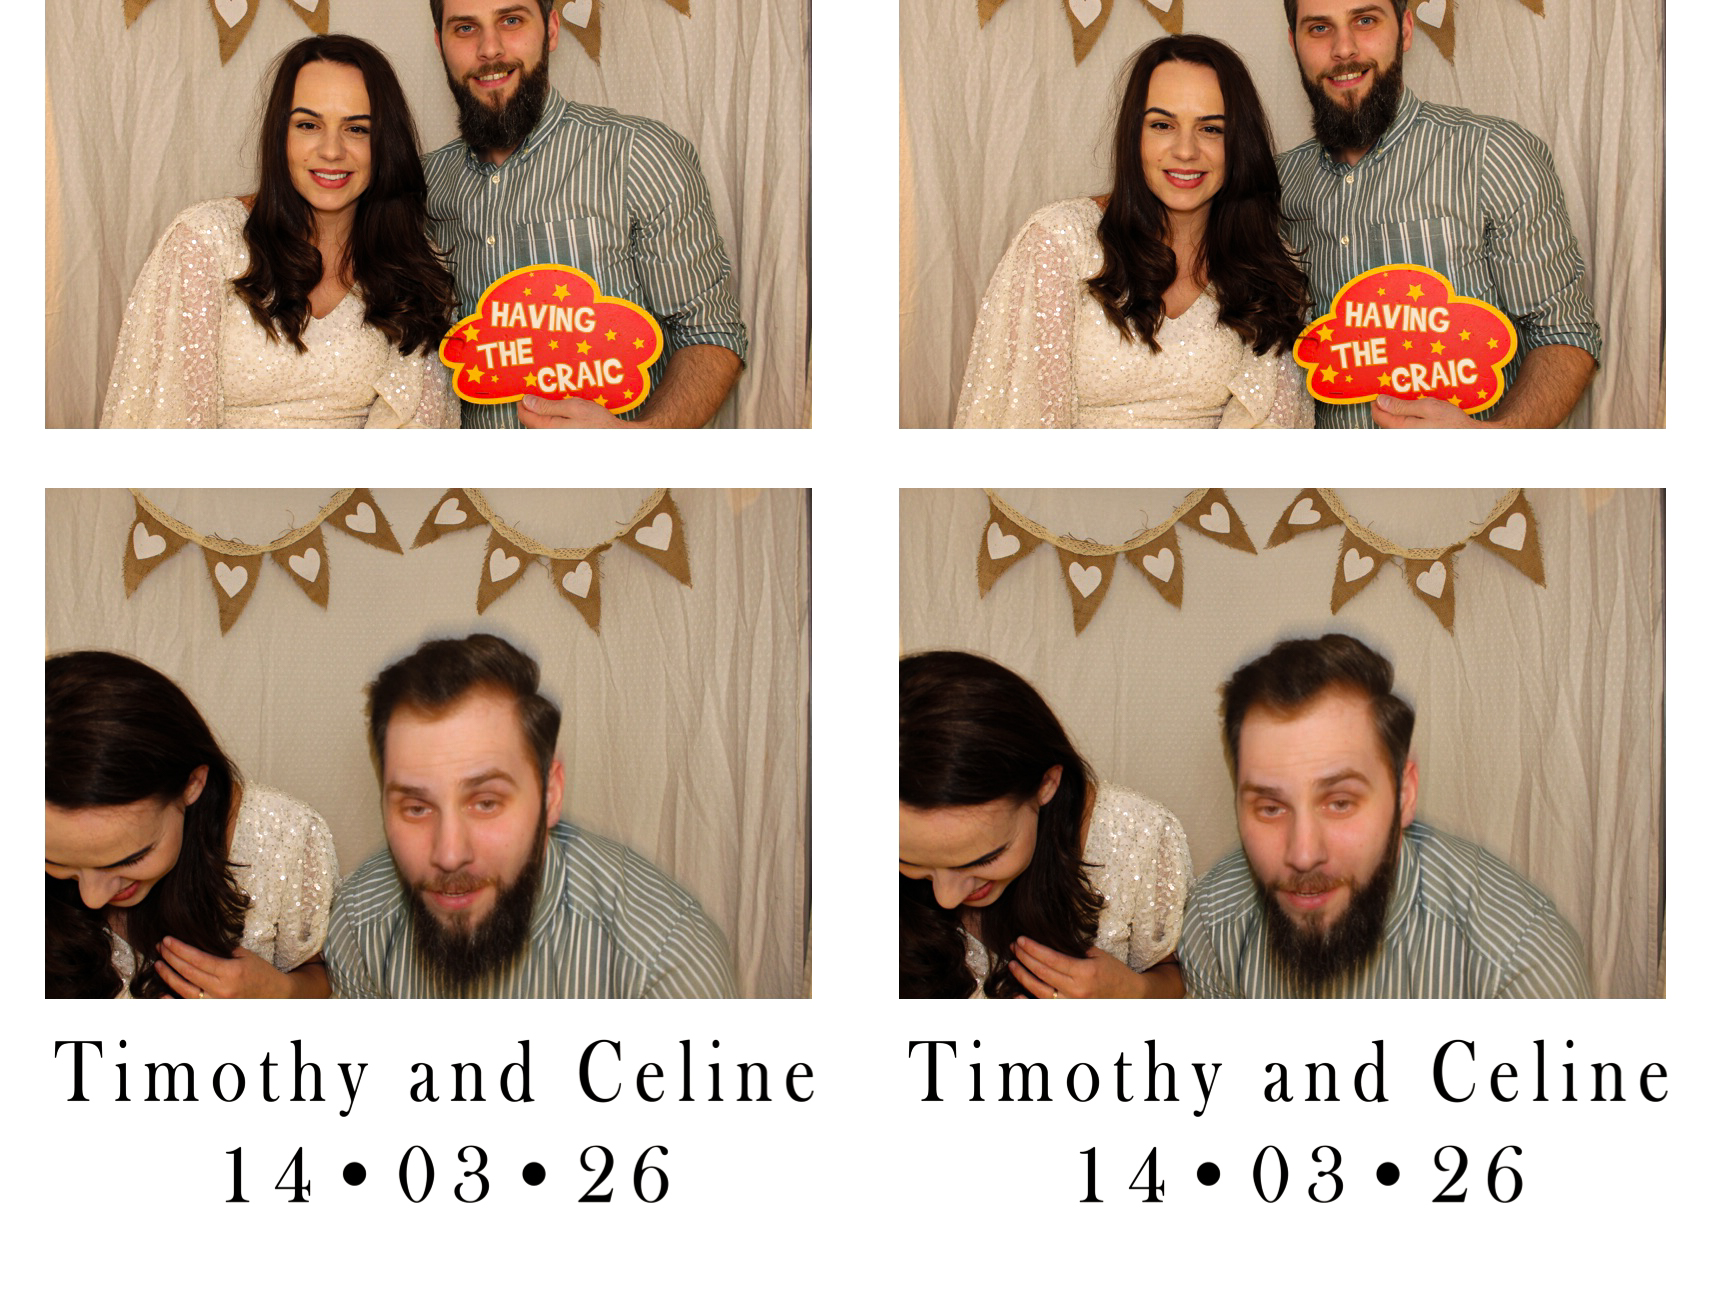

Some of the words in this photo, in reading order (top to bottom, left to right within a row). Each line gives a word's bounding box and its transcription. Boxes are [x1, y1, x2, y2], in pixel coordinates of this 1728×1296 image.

[490, 301, 597, 334] HAVING
[1344, 301, 1451, 334] HAVING
[475, 337, 535, 370] THE
[1329, 337, 1389, 370] THE
[536, 357, 625, 394] CRAIC
[1390, 357, 1479, 394] CRAIC
